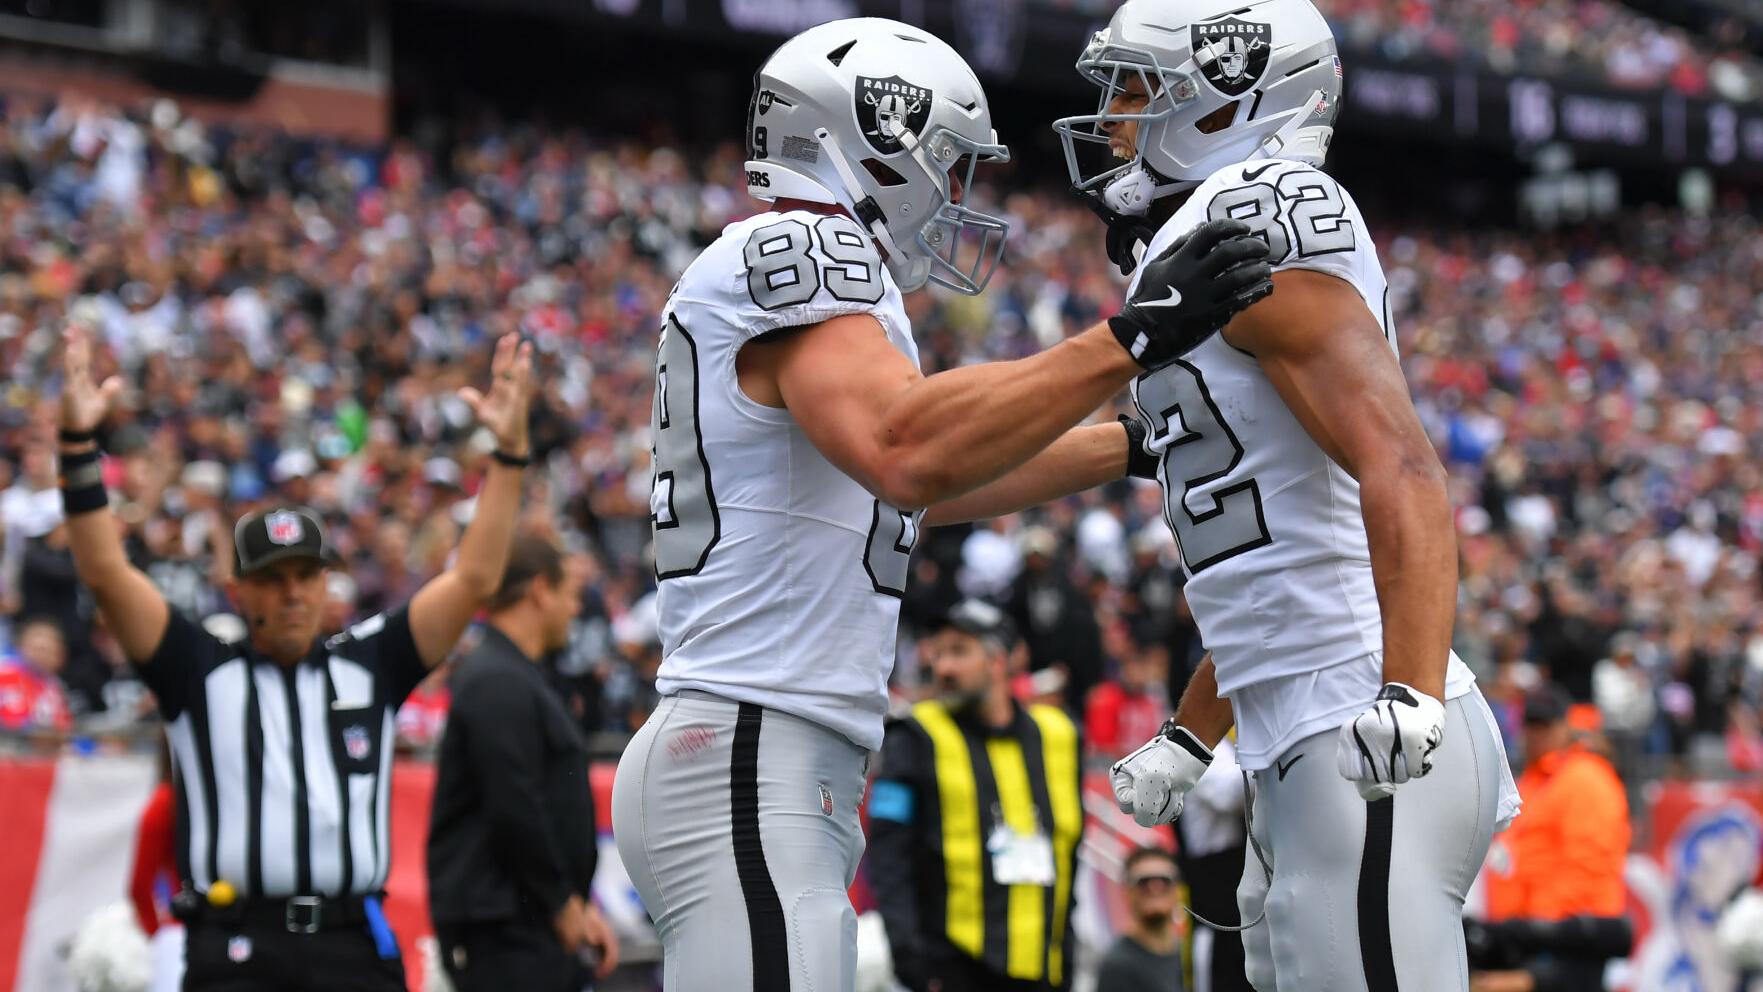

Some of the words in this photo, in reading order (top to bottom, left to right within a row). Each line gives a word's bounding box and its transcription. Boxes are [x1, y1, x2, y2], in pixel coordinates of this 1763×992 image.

[1199, 24, 1264, 34] RAIDERS
[759, 95, 770, 106] AL
[863, 79, 926, 98] RAIDERS
[755, 126, 769, 159] 9
[1207, 171, 1356, 265] 82
[743, 216, 884, 311] 89
